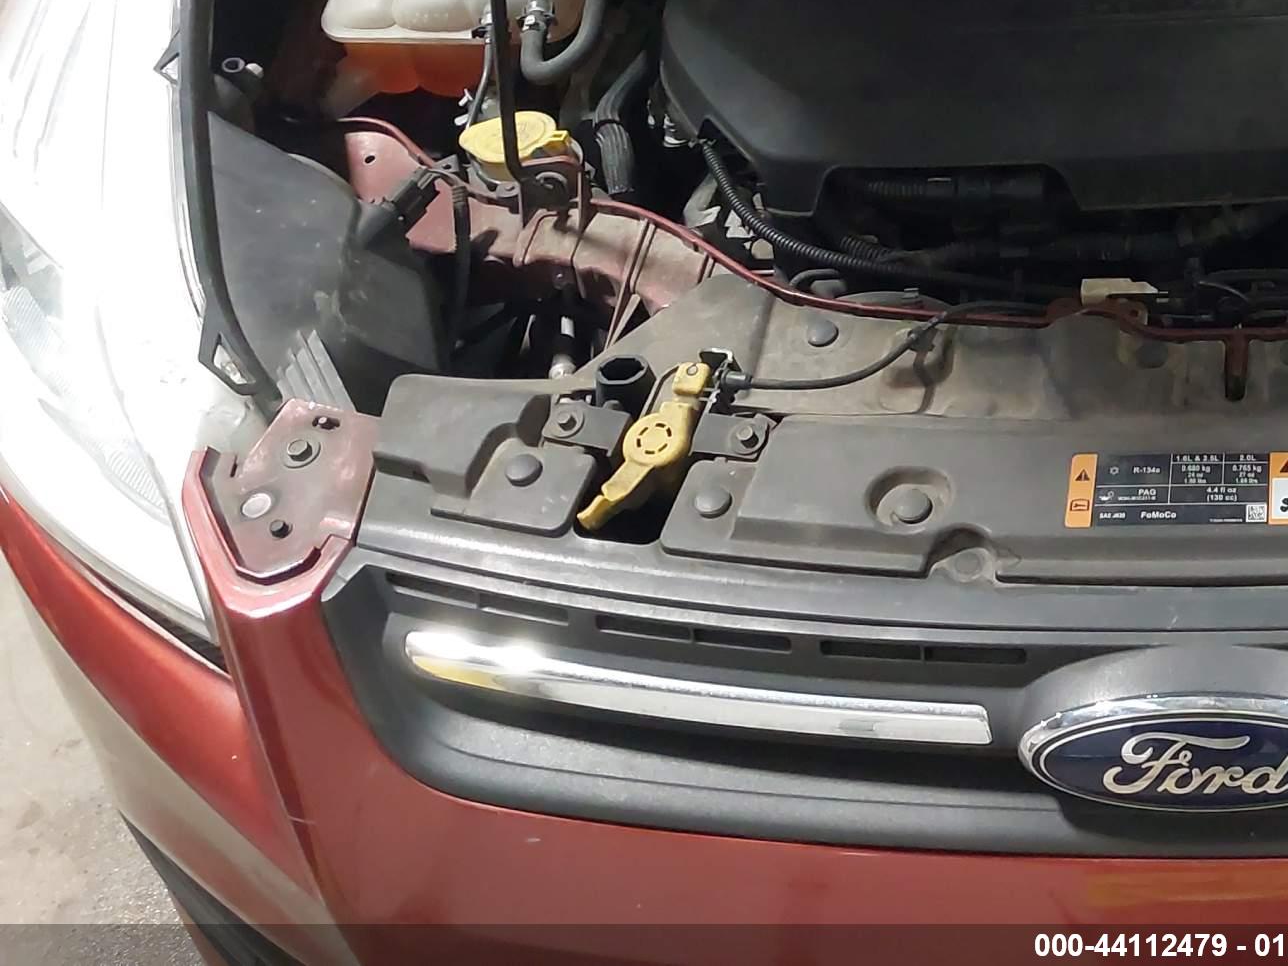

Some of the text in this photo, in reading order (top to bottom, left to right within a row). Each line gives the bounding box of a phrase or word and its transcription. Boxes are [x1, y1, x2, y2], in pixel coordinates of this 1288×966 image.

[1132, 466, 1161, 475] R-134a
[1138, 489, 1157, 497] PAG
[1140, 511, 1177, 520] FoMoCo
